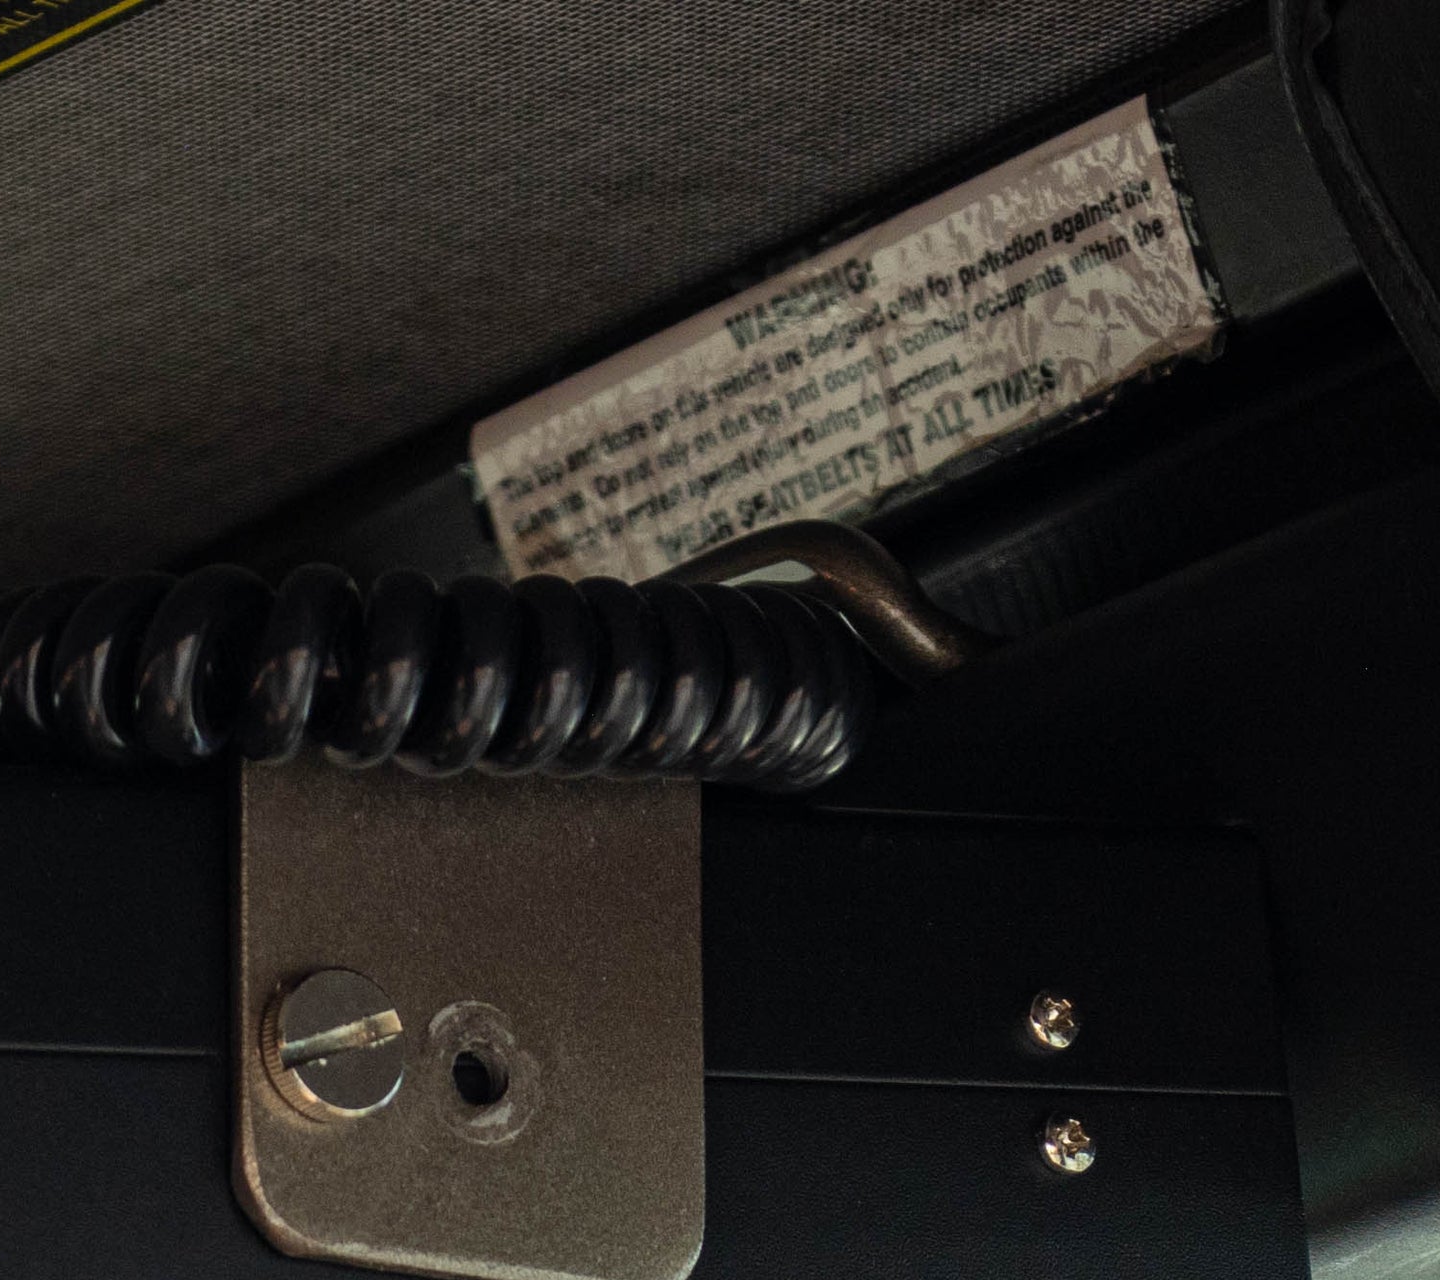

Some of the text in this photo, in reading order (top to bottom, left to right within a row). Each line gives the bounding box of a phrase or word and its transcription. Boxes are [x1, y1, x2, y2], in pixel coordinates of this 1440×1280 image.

[926, 275, 953, 298] for
[959, 230, 1047, 292] protection
[1051, 193, 1120, 243] against
[974, 266, 1066, 320] occupants
[1071, 235, 1130, 272] within
[1134, 218, 1165, 246] the
[738, 445, 877, 528] SEATBELTS
[879, 424, 913, 462] AT
[922, 398, 973, 443] ALL
